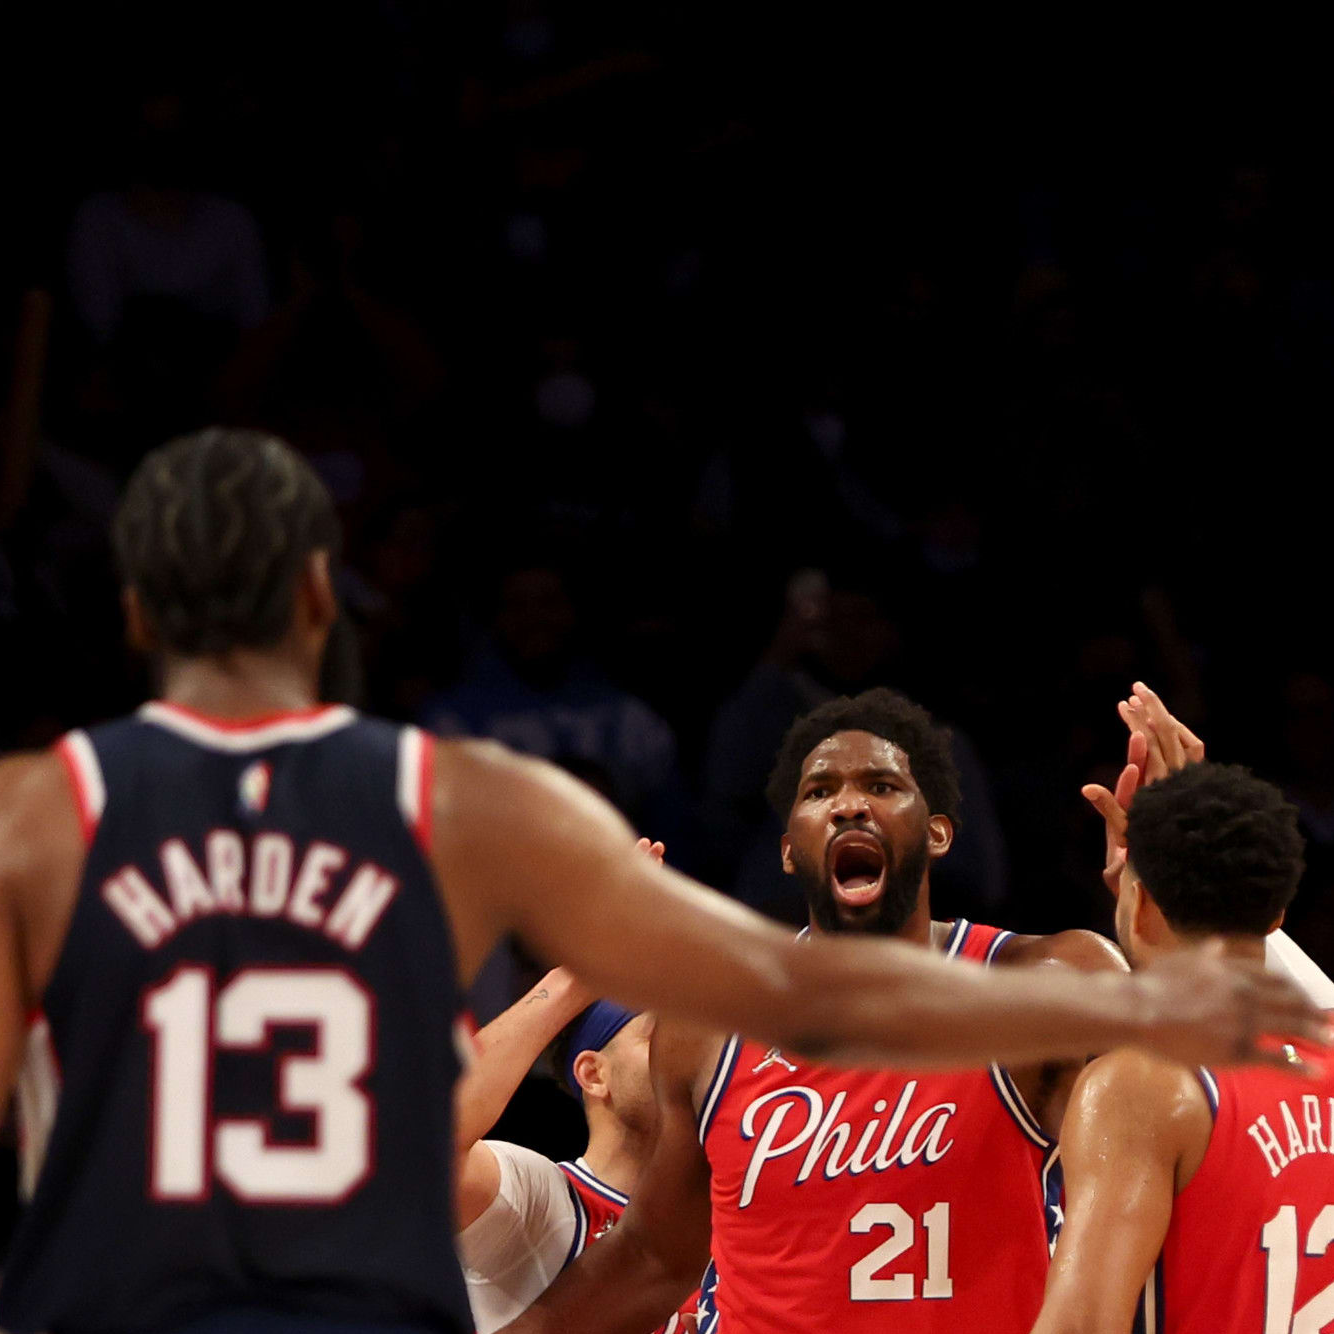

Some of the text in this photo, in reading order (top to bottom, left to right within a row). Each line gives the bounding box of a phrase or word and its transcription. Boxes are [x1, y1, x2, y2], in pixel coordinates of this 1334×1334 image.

[101, 828, 400, 949] HARDEN
[139, 963, 375, 1204] 13
[739, 1079, 958, 1209] Phila
[849, 1202, 954, 1301] 21
